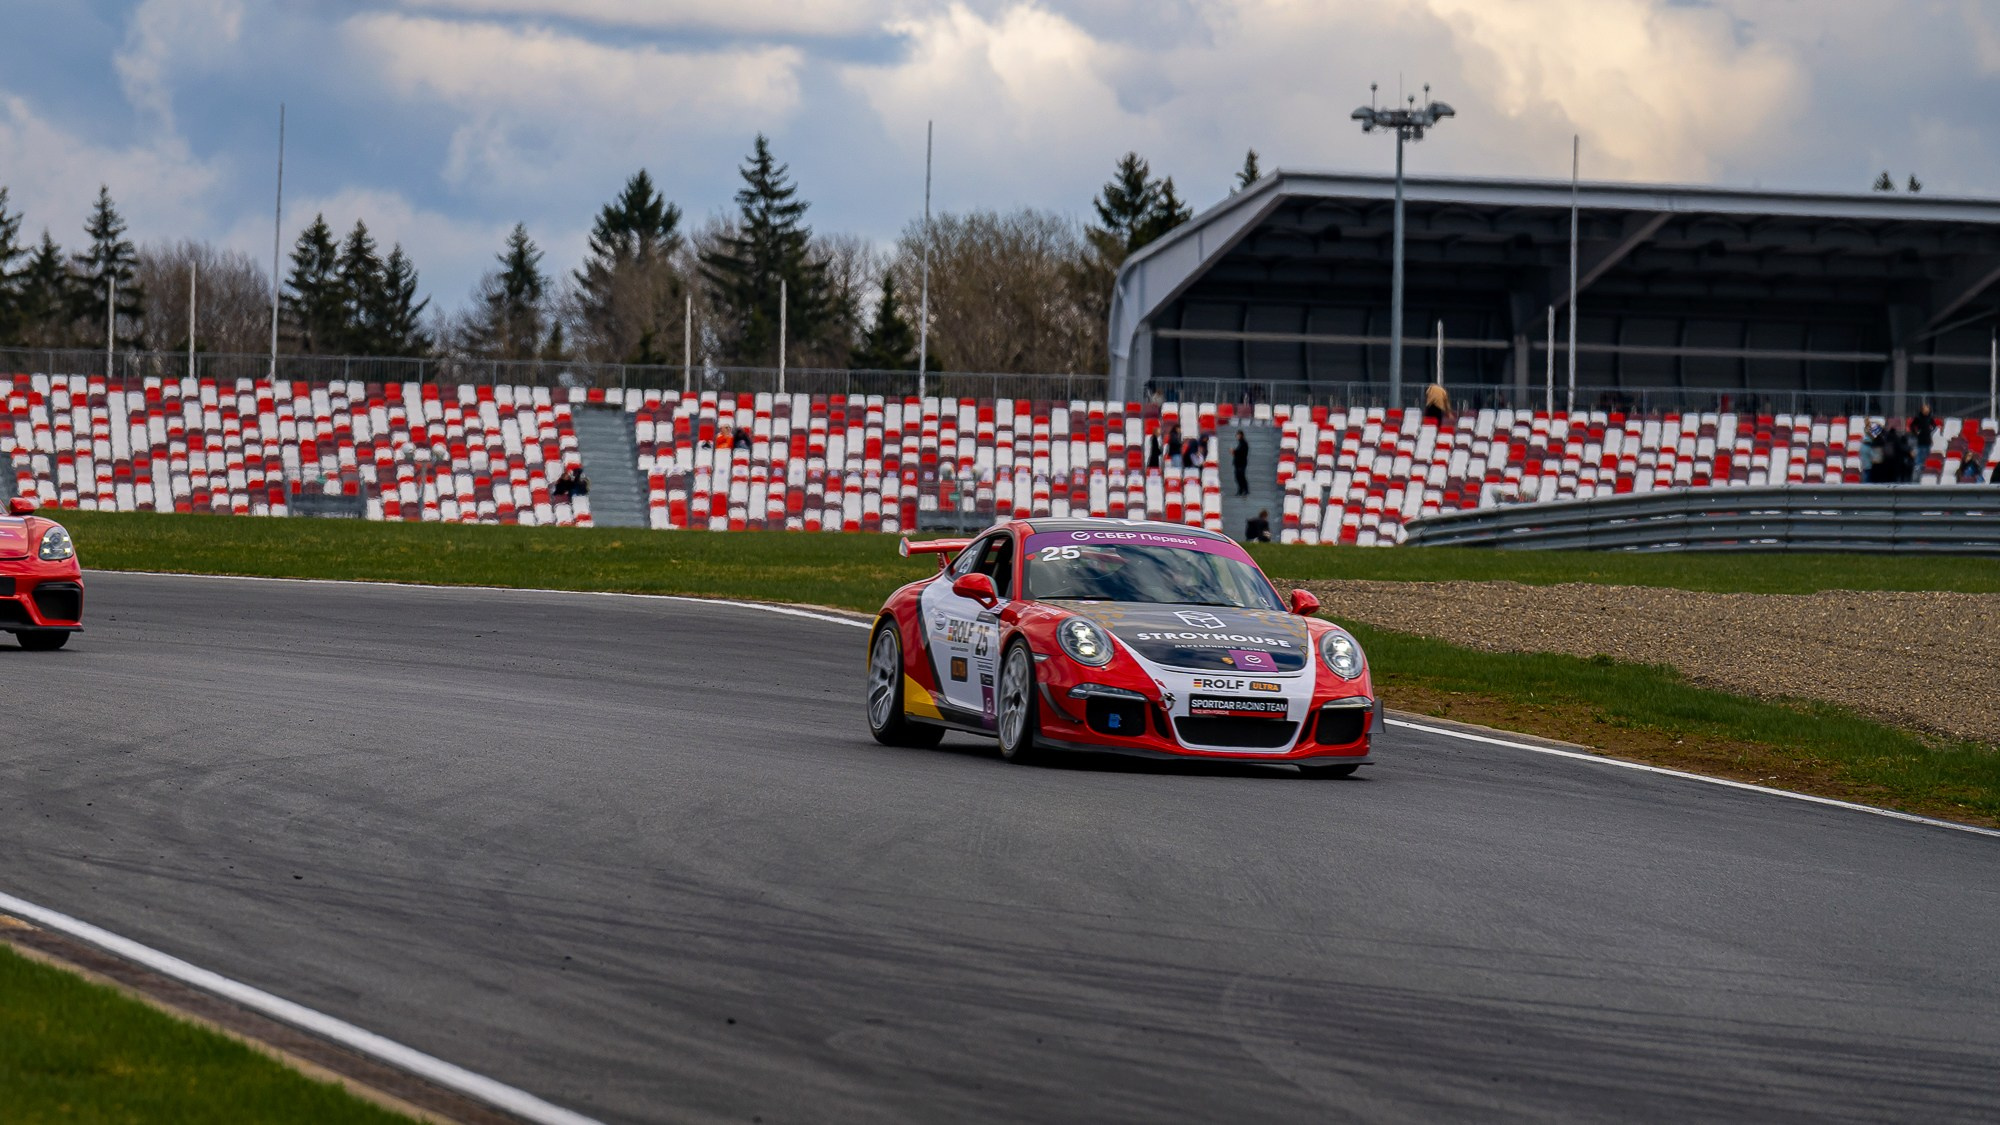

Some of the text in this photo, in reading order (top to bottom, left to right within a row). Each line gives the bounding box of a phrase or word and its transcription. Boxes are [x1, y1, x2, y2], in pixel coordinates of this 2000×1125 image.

[1093, 531, 1198, 546] СБЕР Первый
[1040, 545, 1081, 562] 25
[975, 624, 990, 657] 25
[1137, 632, 1291, 648] STROYHOUSE
[1202, 678, 1279, 691] ROLF ULTRA
[1191, 699, 1287, 712] SPORTCAR RACING TEAM
